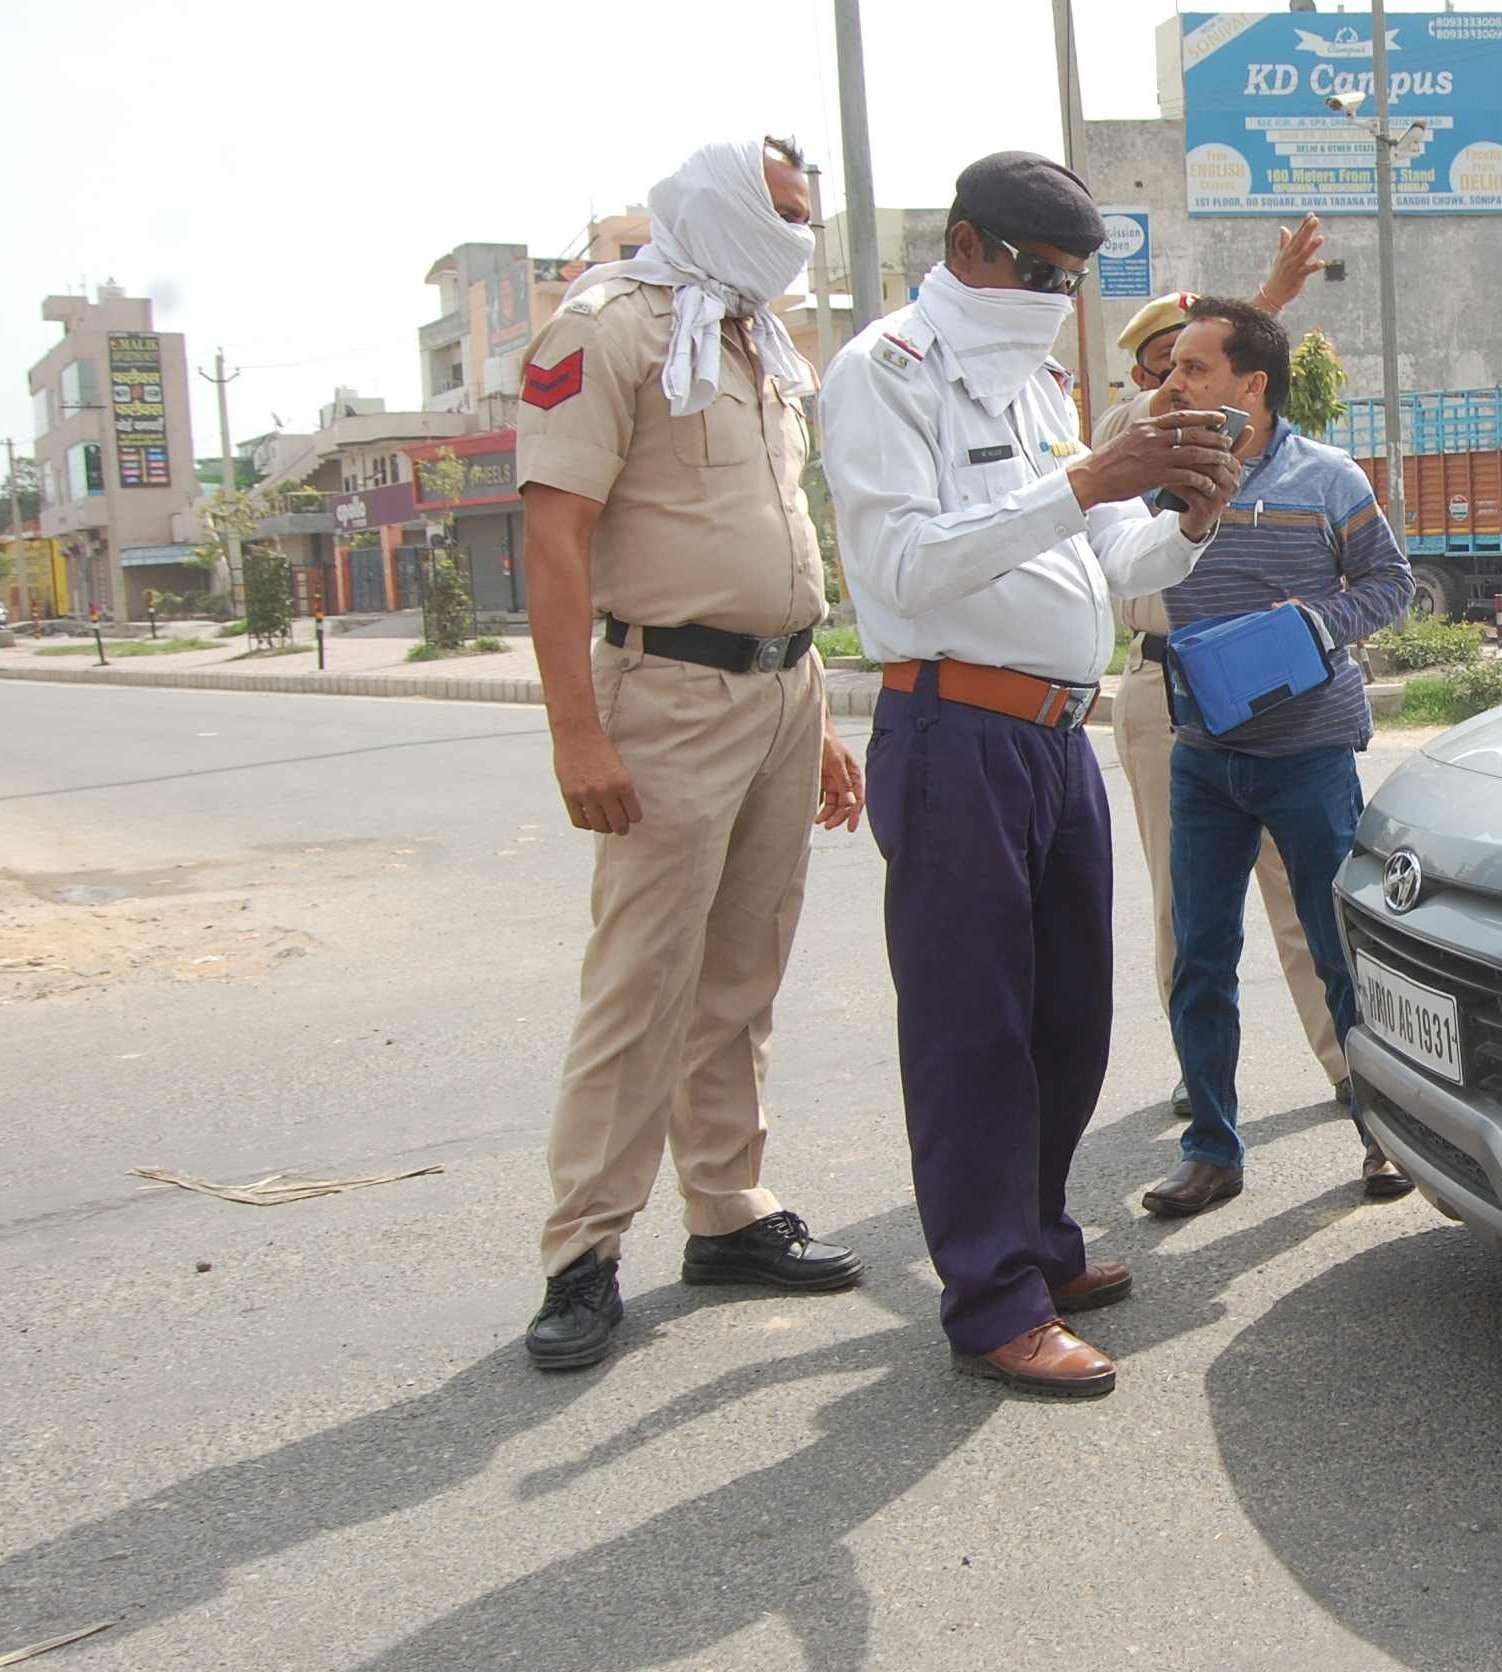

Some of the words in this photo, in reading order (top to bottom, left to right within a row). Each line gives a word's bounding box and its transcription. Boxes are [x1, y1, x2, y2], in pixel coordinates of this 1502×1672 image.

[1243, 64, 1298, 95] KD
[1340, 168, 1371, 183] From
[1401, 168, 1436, 183] Stand
[1104, 241, 1130, 253] Open
[1416, 1005, 1454, 1064] 1931
